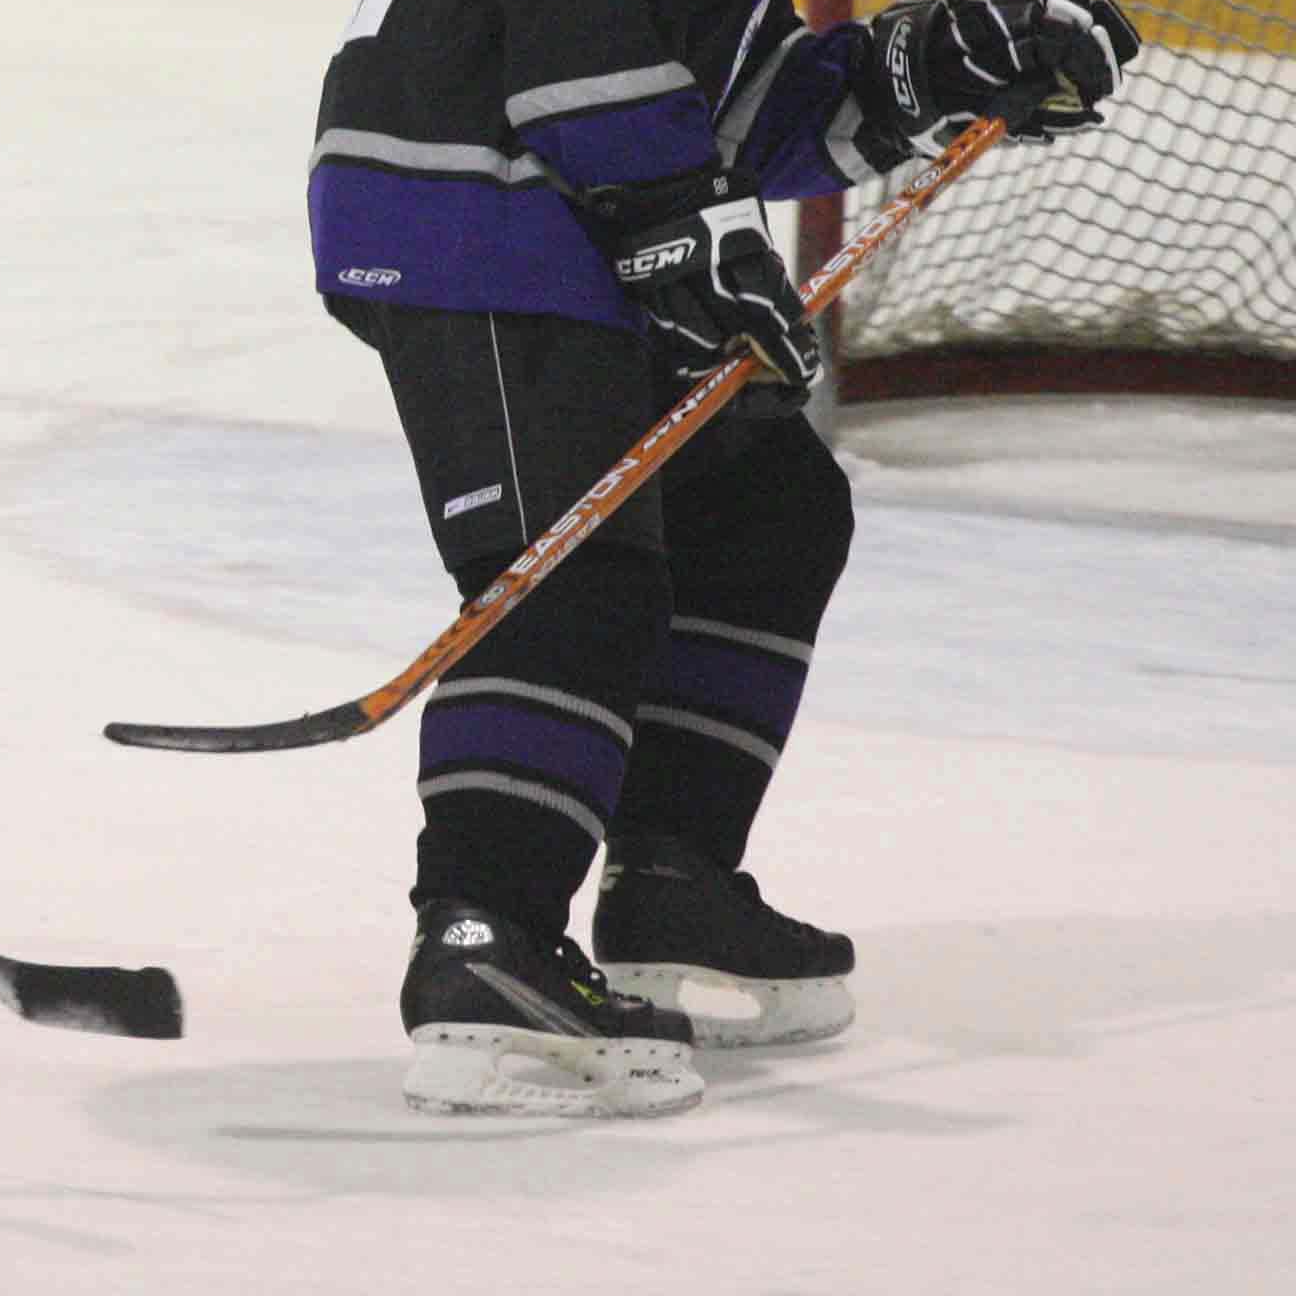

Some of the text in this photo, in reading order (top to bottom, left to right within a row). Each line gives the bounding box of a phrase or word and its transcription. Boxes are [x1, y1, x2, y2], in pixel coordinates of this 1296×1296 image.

[617, 244, 688, 275] CCM
[345, 268, 397, 286] CCM
[510, 457, 641, 574] EASTON
